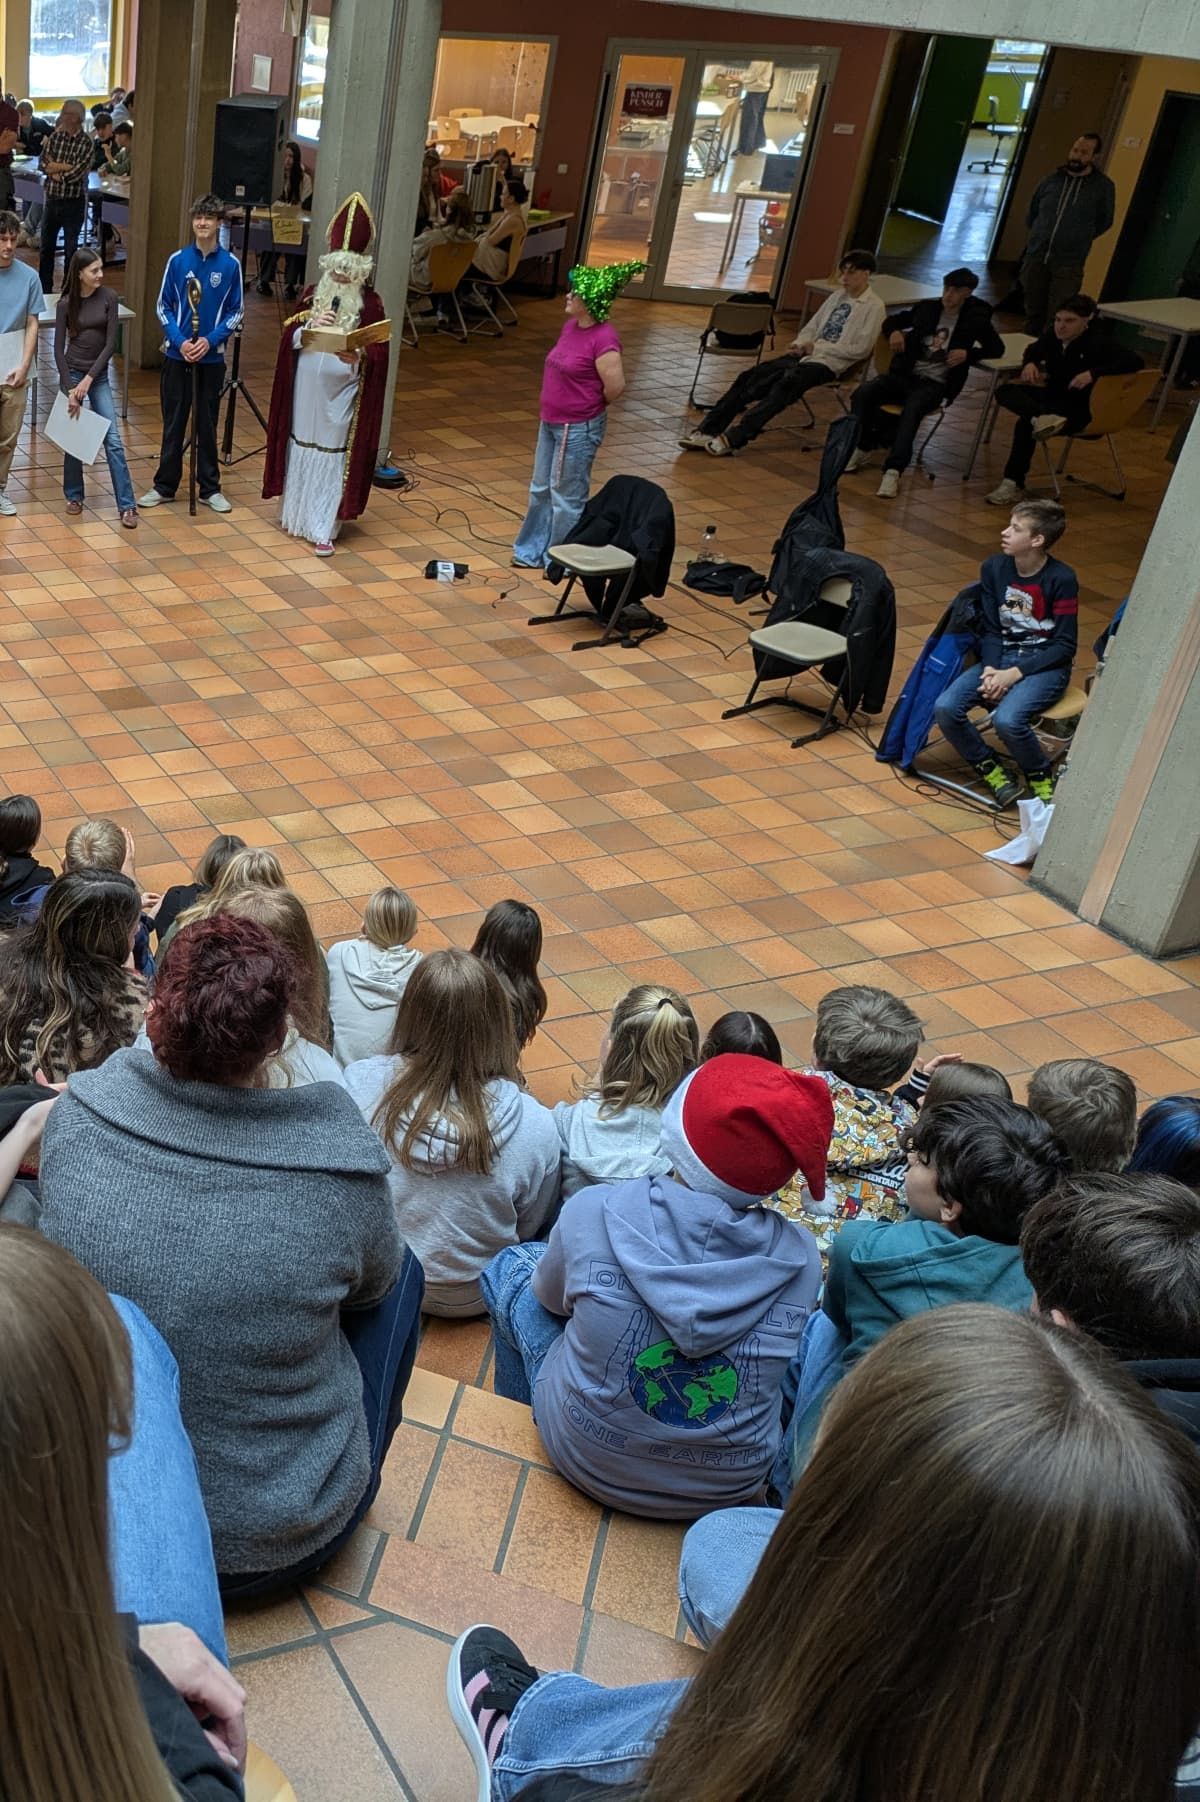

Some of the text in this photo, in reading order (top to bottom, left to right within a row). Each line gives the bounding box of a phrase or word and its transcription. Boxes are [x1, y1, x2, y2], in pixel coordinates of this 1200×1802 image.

[629, 98, 664, 108] PUNSCH
[596, 1270, 800, 1329] ON LY
[568, 1404, 761, 1466] ONE EARTH
